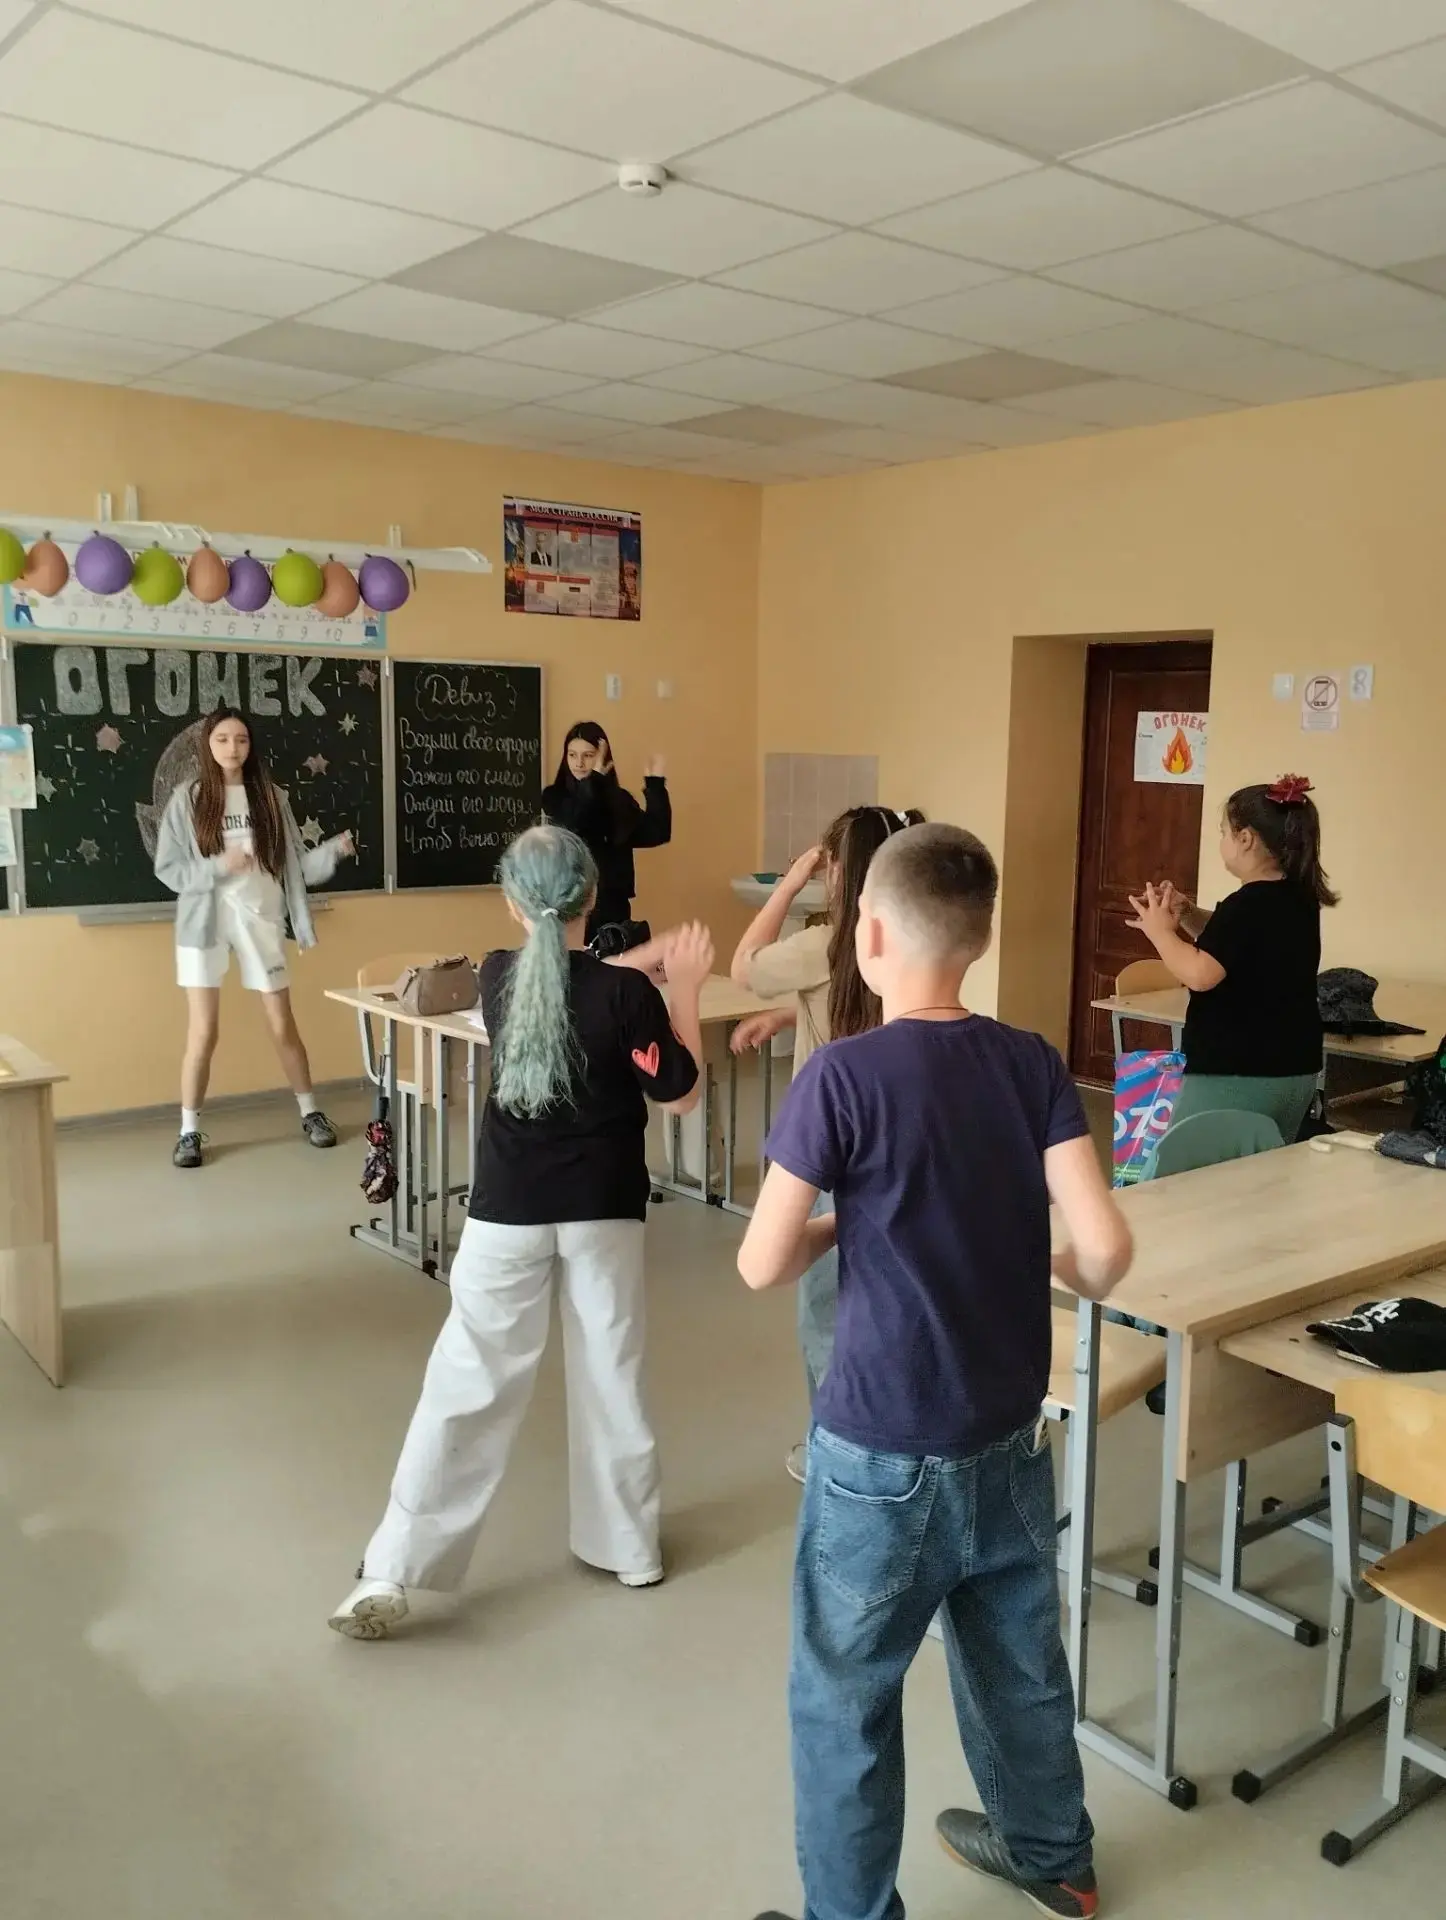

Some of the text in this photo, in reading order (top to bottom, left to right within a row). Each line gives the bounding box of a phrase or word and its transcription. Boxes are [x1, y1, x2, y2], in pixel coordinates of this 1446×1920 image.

[53, 645, 327, 718] ОГОНЕК
[424, 674, 496, 717] Девиз
[399, 717, 459, 764] Возьми
[1154, 713, 1207, 732] ОГОНЕК
[404, 791, 456, 829] Отдай
[404, 825, 453, 854] Чтоб
